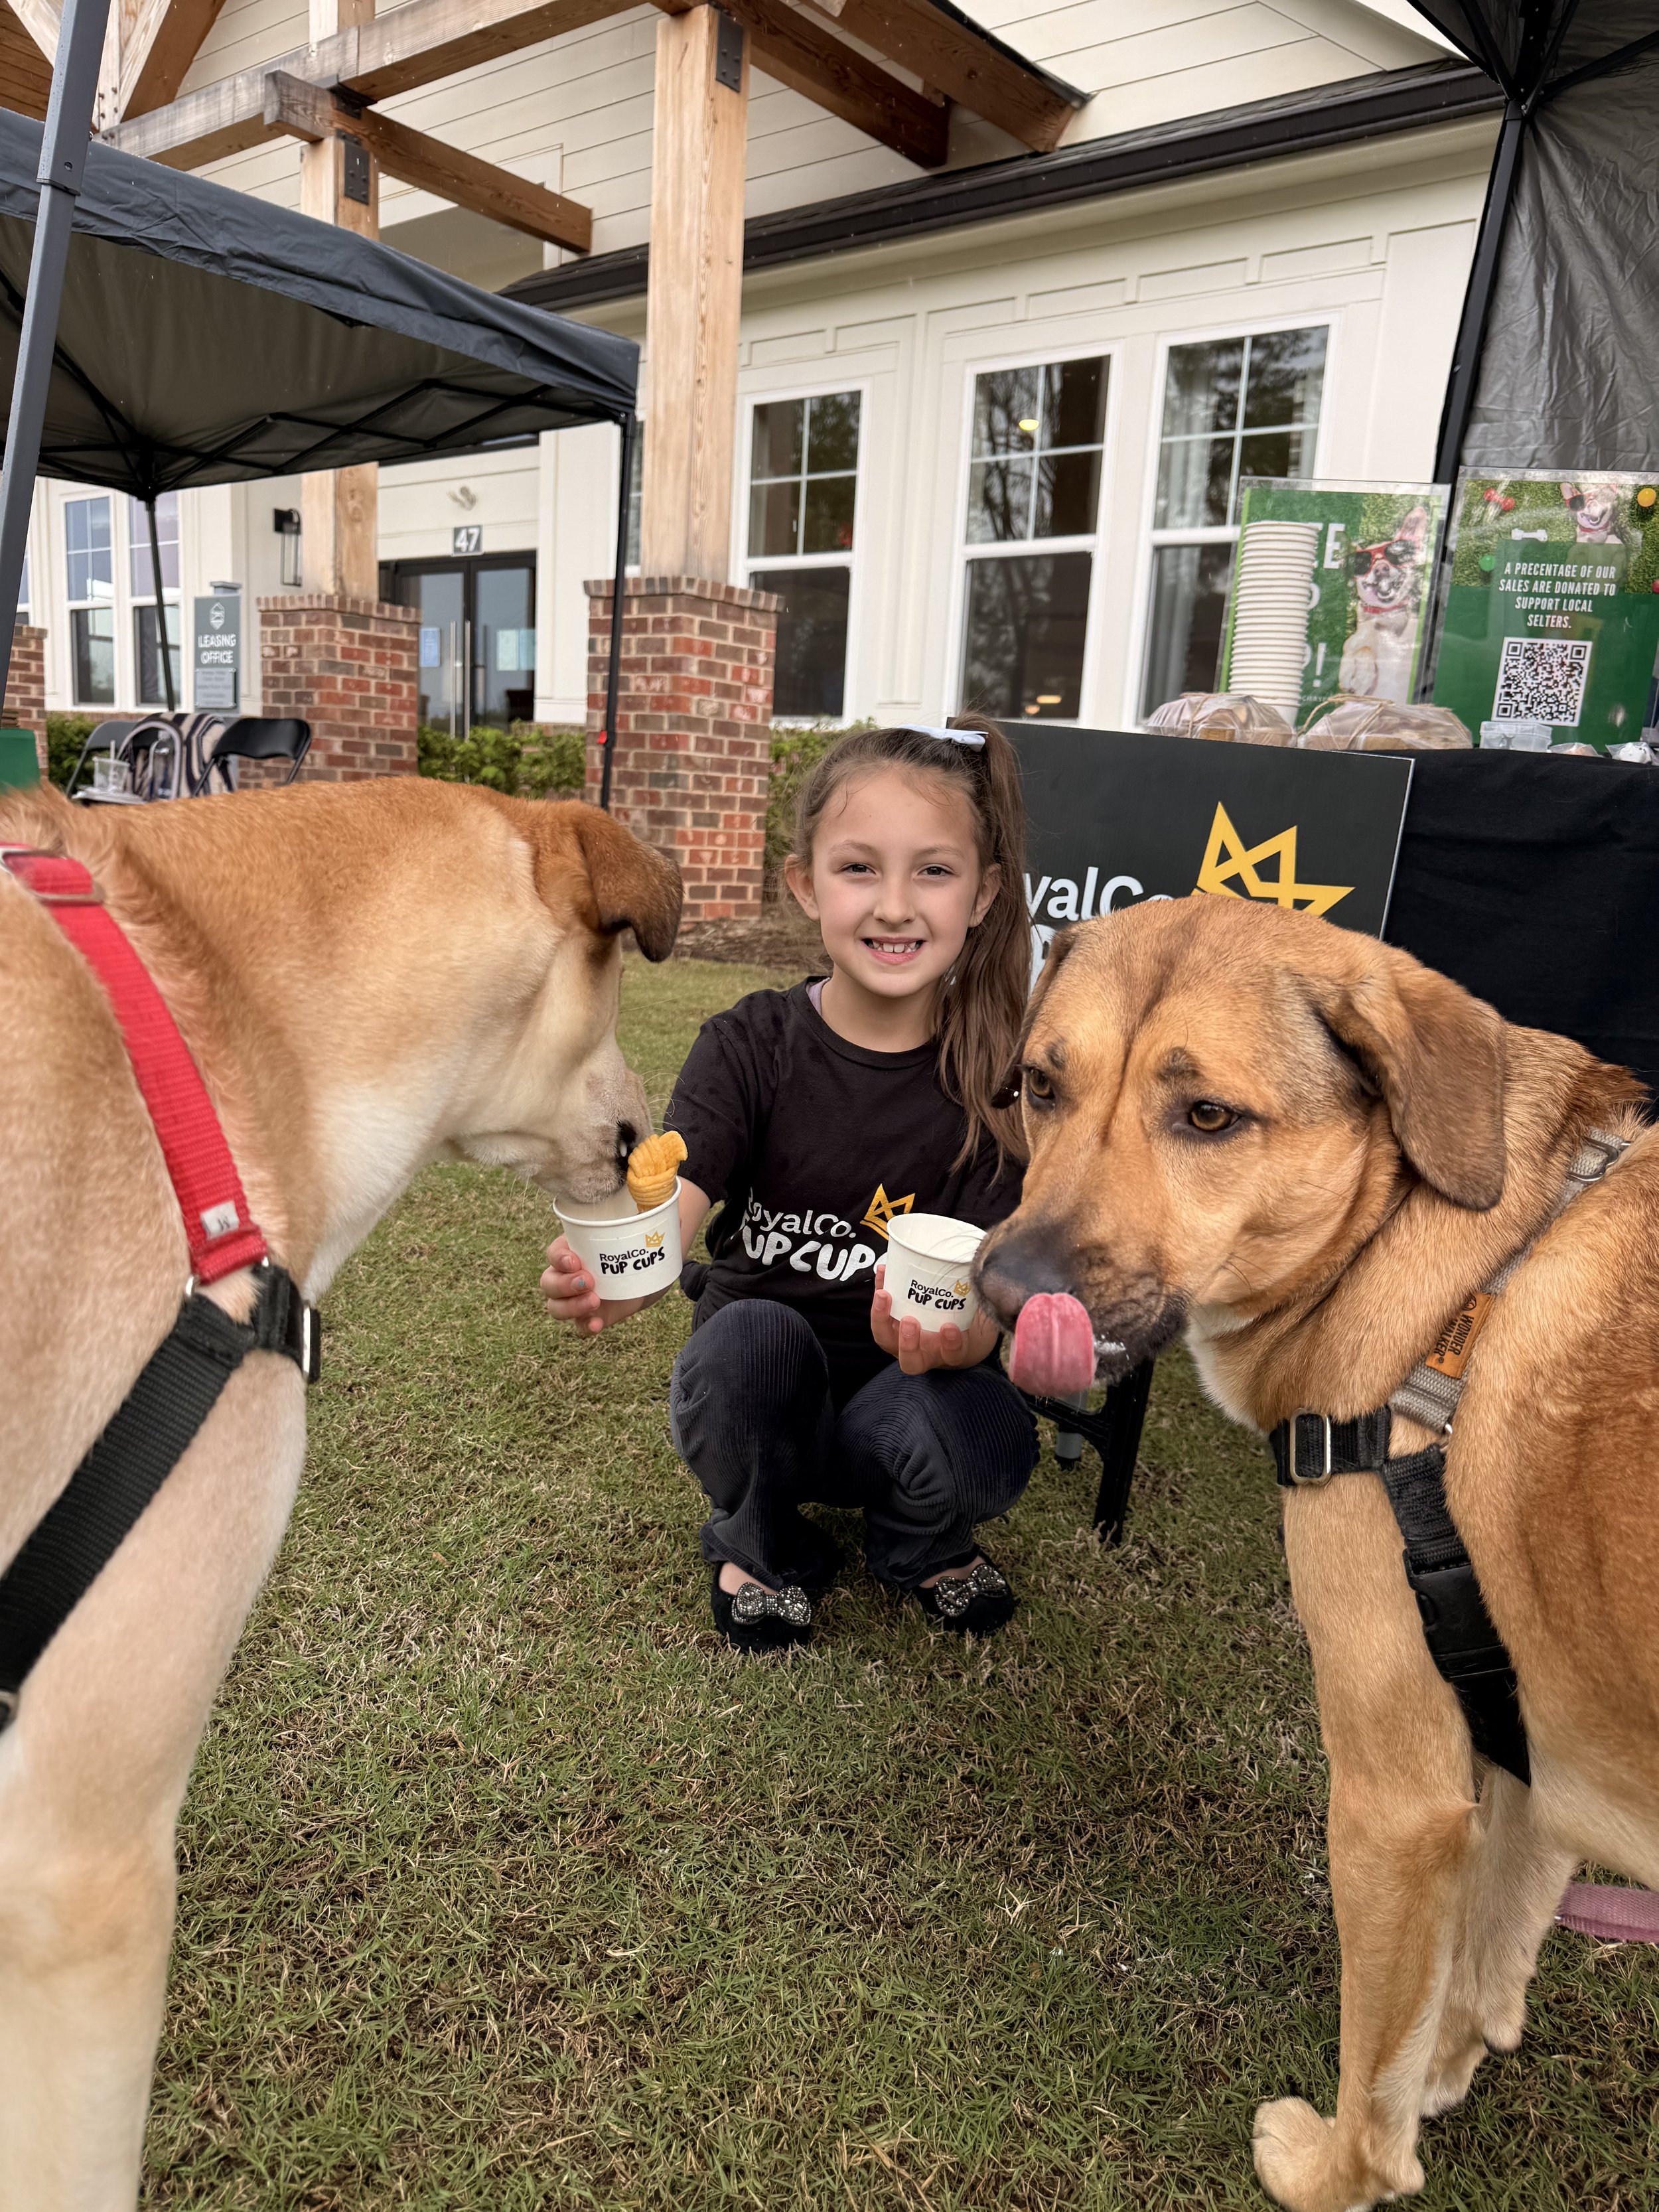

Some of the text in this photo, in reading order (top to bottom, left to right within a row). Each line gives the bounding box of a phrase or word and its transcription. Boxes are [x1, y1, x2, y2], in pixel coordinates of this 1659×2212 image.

[455, 528, 480, 552] 47
[1504, 562, 1617, 579] A PRECENTAGE OF OUR
[1498, 579, 1617, 596] SALES ARE DONATED TO
[1515, 596, 1593, 612] SUPPORT LOCAL
[1527, 614, 1572, 628] SELTERS.
[198, 634, 236, 648] LEASING
[200, 650, 234, 664] OFFICE
[599, 1248, 649, 1264] RoyalCo.
[735, 1215, 888, 1282] UP CUP
[601, 1246, 665, 1274] PUP CUPS
[910, 1280, 954, 1297] RoyalCo.
[907, 1288, 966, 1310] PUP CUPS
[1447, 1314, 1474, 1355] WONDER
